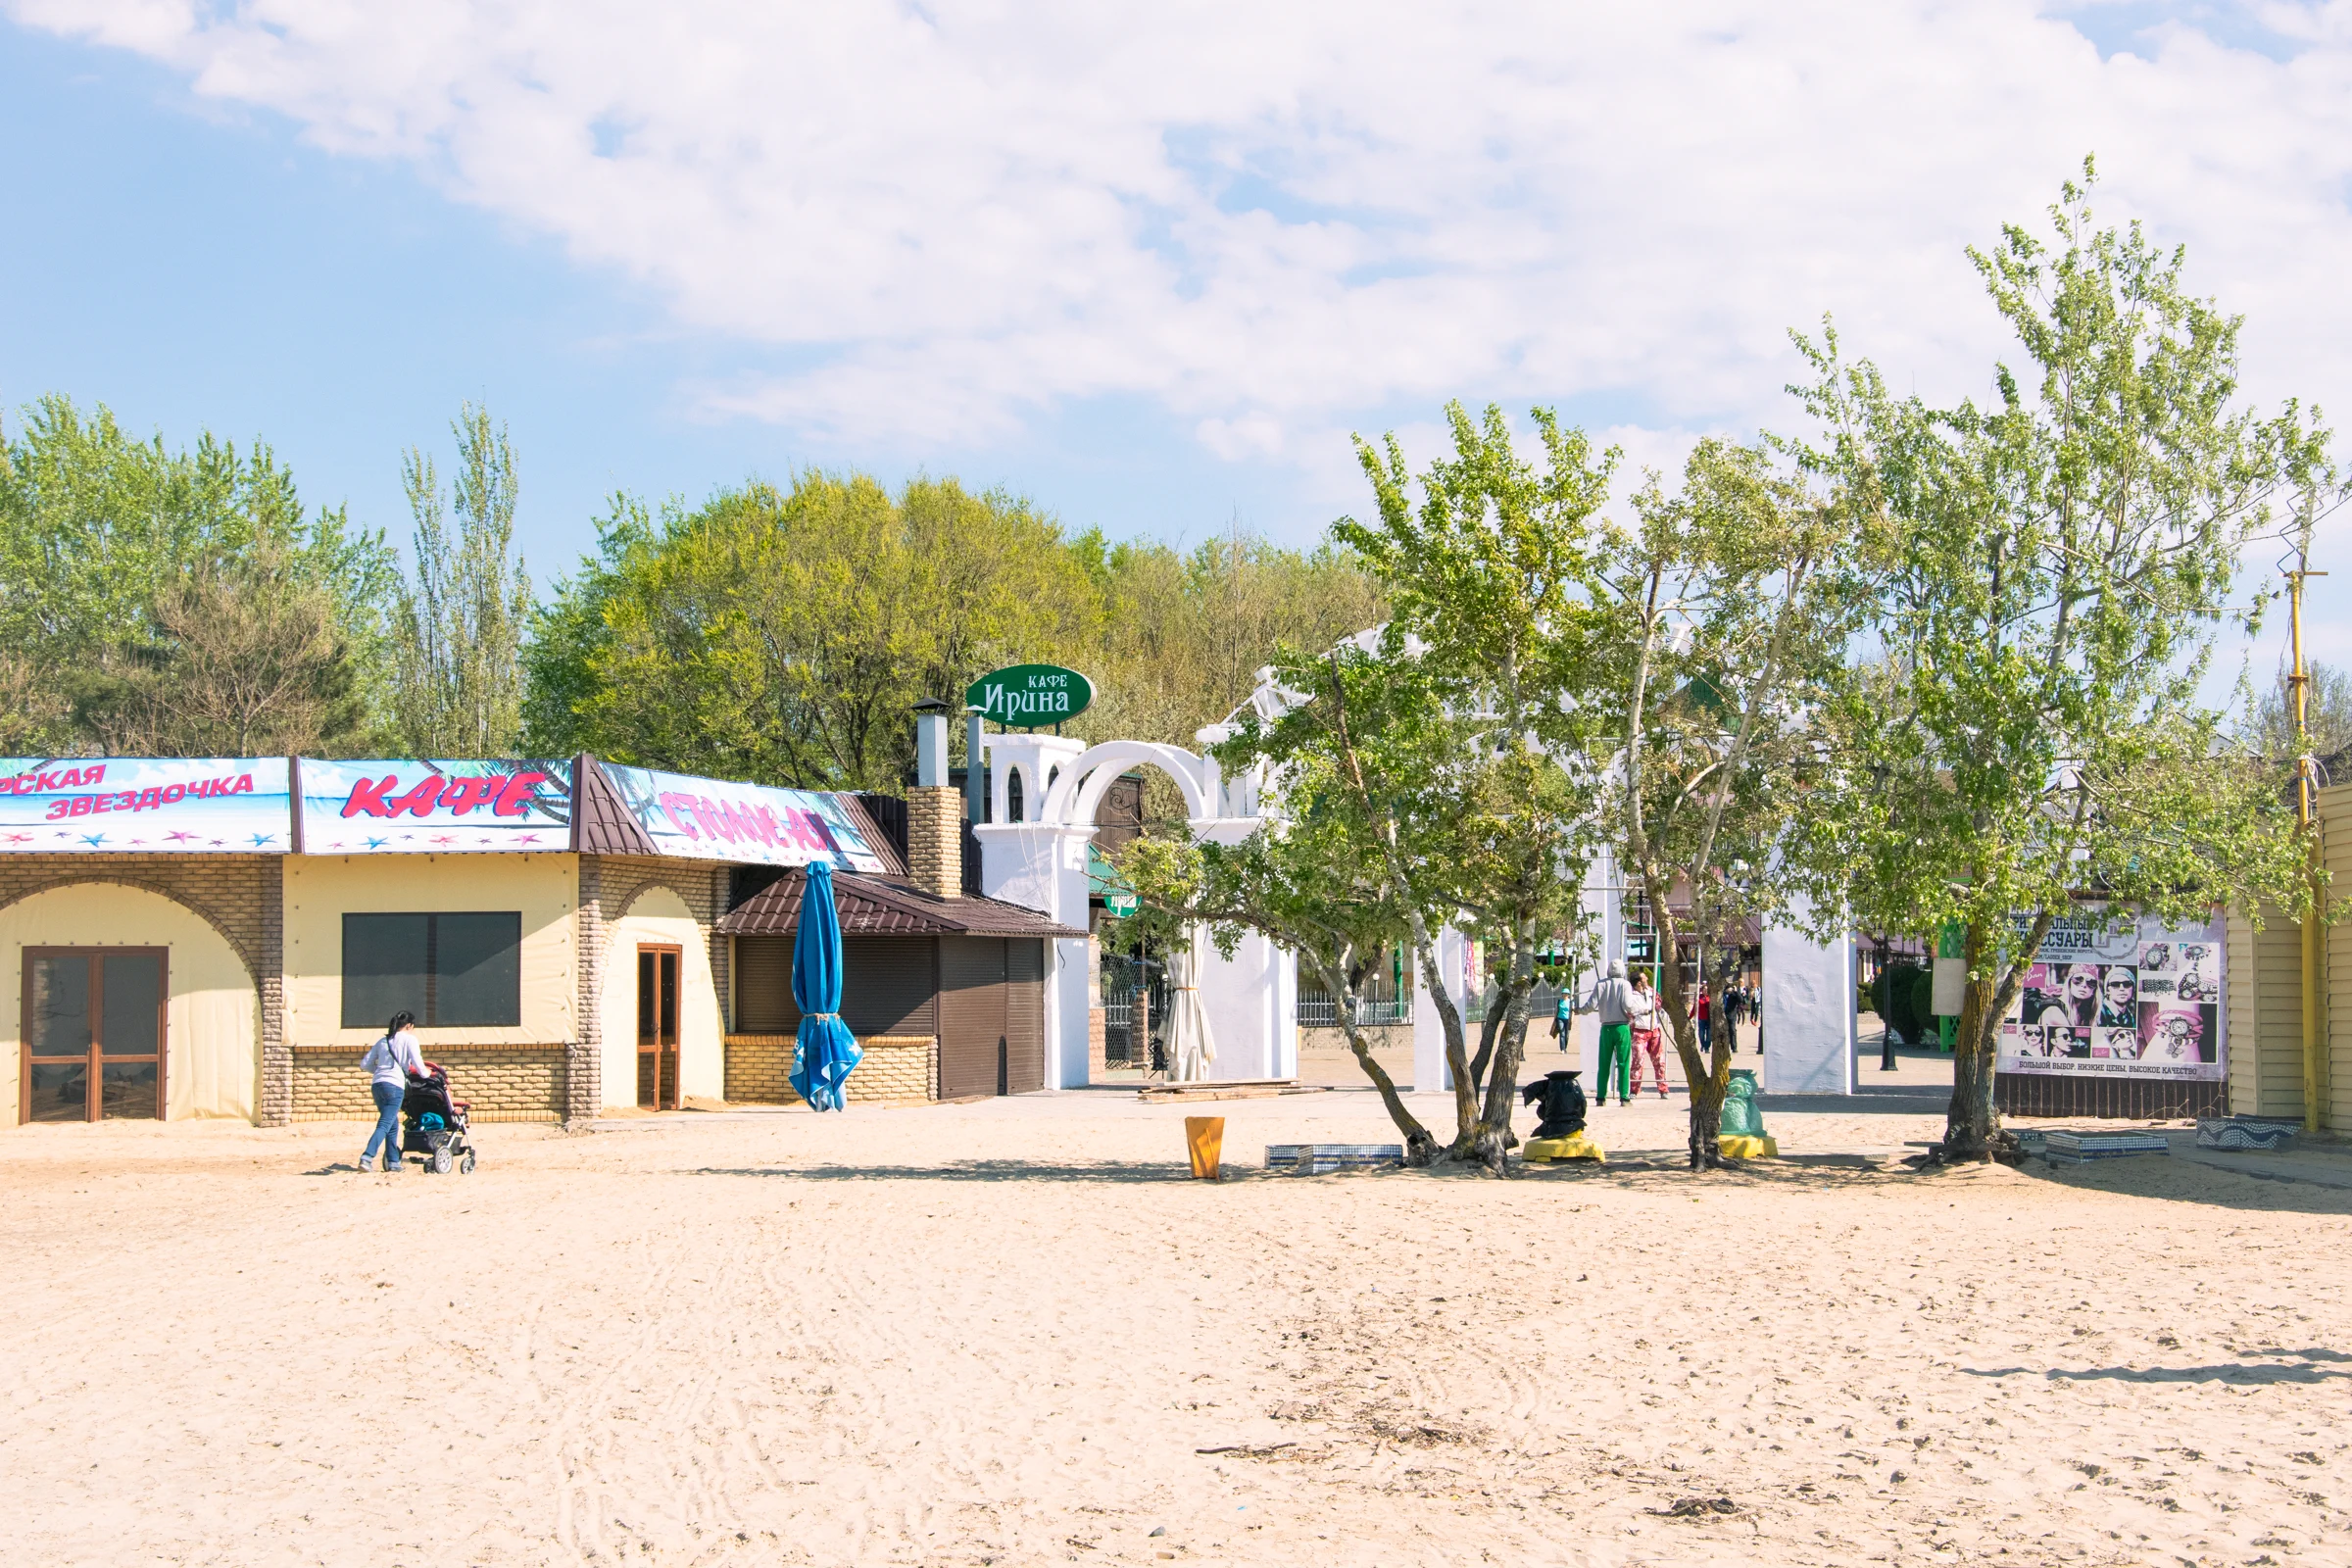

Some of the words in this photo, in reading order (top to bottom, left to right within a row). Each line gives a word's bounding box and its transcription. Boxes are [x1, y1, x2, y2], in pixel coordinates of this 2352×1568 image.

[1028, 675, 1068, 689] КАФЕ
[983, 683, 1070, 721] Ирина
[45, 773, 255, 820] ЗВЕЗДОЧКА
[339, 771, 546, 819] КАФЕ
[2019, 1060, 2051, 1069] БОЛЬШОЙ
[2129, 1065, 2161, 1074] ВЫСОКОЕ
[2162, 1066, 2197, 1075] КАЧЕСТВО
